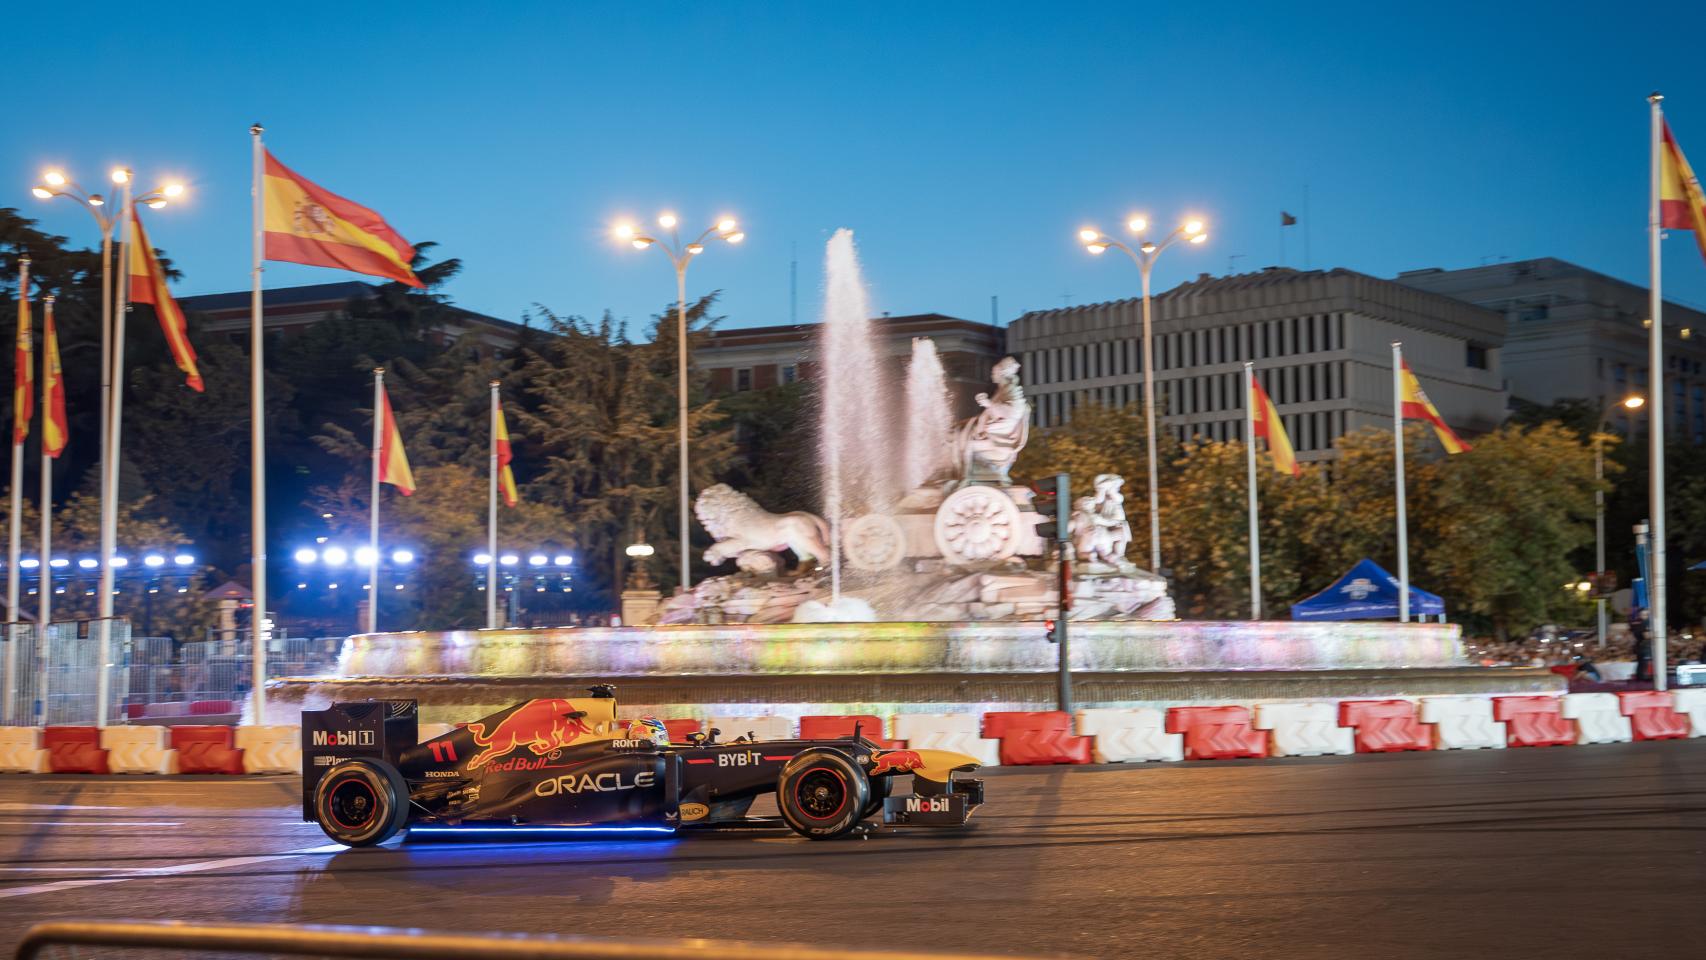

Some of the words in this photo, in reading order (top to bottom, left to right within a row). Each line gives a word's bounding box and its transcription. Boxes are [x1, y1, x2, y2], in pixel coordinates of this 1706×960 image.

[313, 730, 356, 746] Mobil
[612, 739, 641, 748] ROKT
[427, 741, 458, 762] 11
[718, 750, 762, 767] BYBIT
[485, 758, 516, 774] Red
[514, 757, 548, 771] Bull
[534, 771, 656, 797] ORACLE
[681, 807, 704, 816] RAUCH
[906, 799, 950, 812] Mobil
